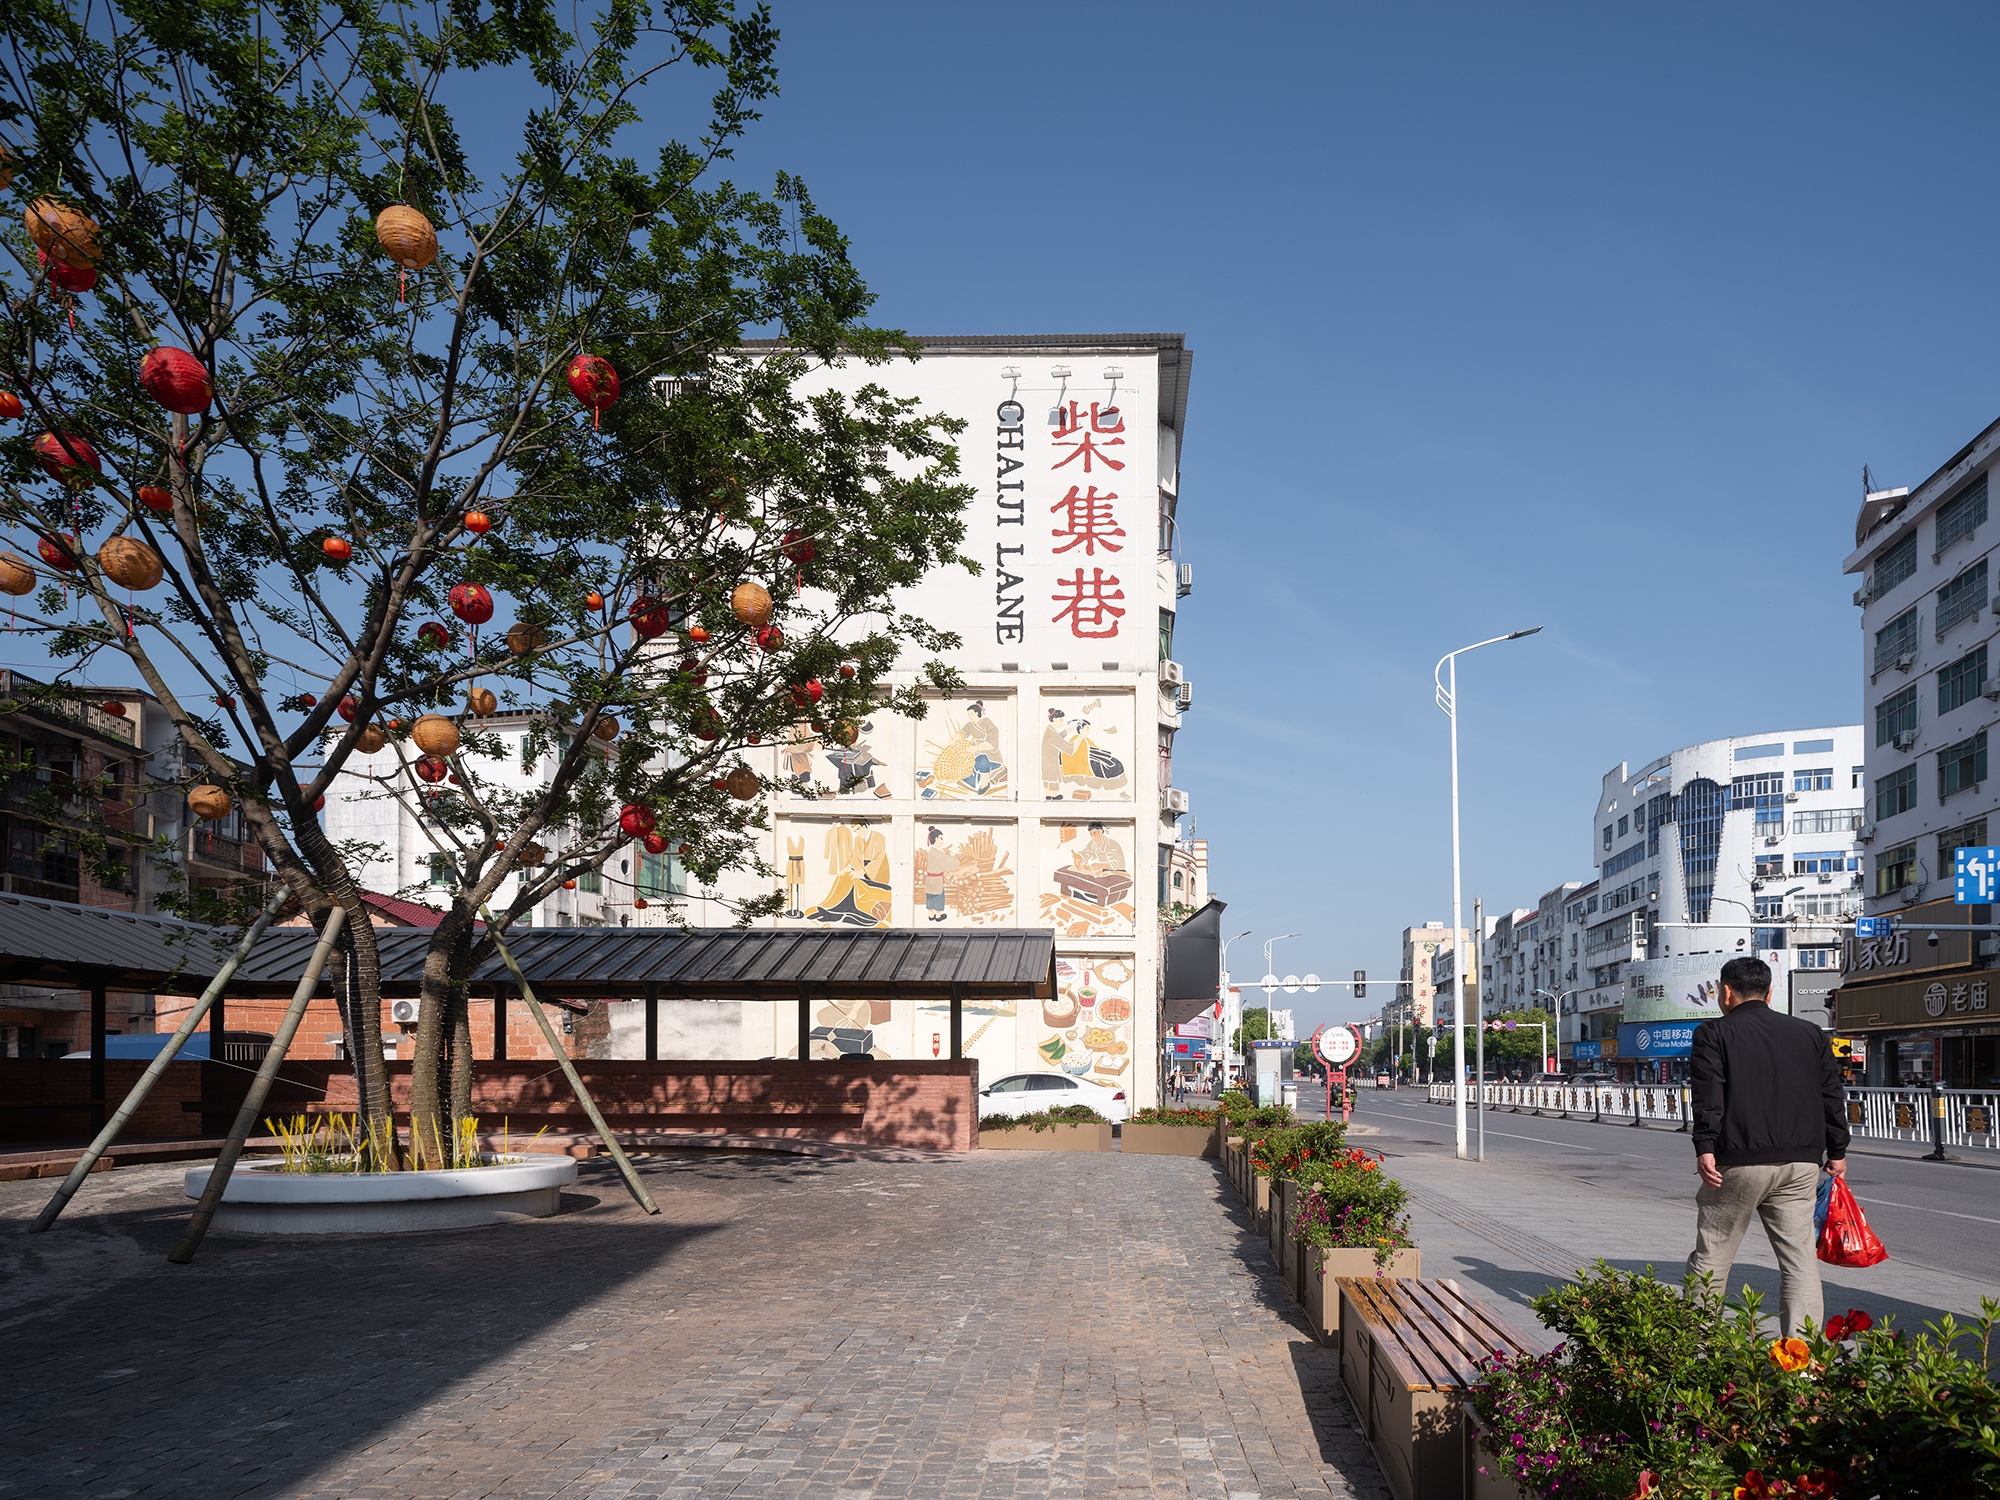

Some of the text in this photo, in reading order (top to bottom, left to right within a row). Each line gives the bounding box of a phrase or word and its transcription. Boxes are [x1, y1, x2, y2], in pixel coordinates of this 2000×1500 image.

[997, 400, 1024, 645] CHAIJI LANE
[1051, 400, 1126, 639] 柴集巷
[1631, 976, 1645, 989] 夏日
[1952, 980, 1988, 1012] 老庙
[1653, 1029, 1692, 1040] 中国移动
[1671, 1040, 1692, 1048] Mobile
